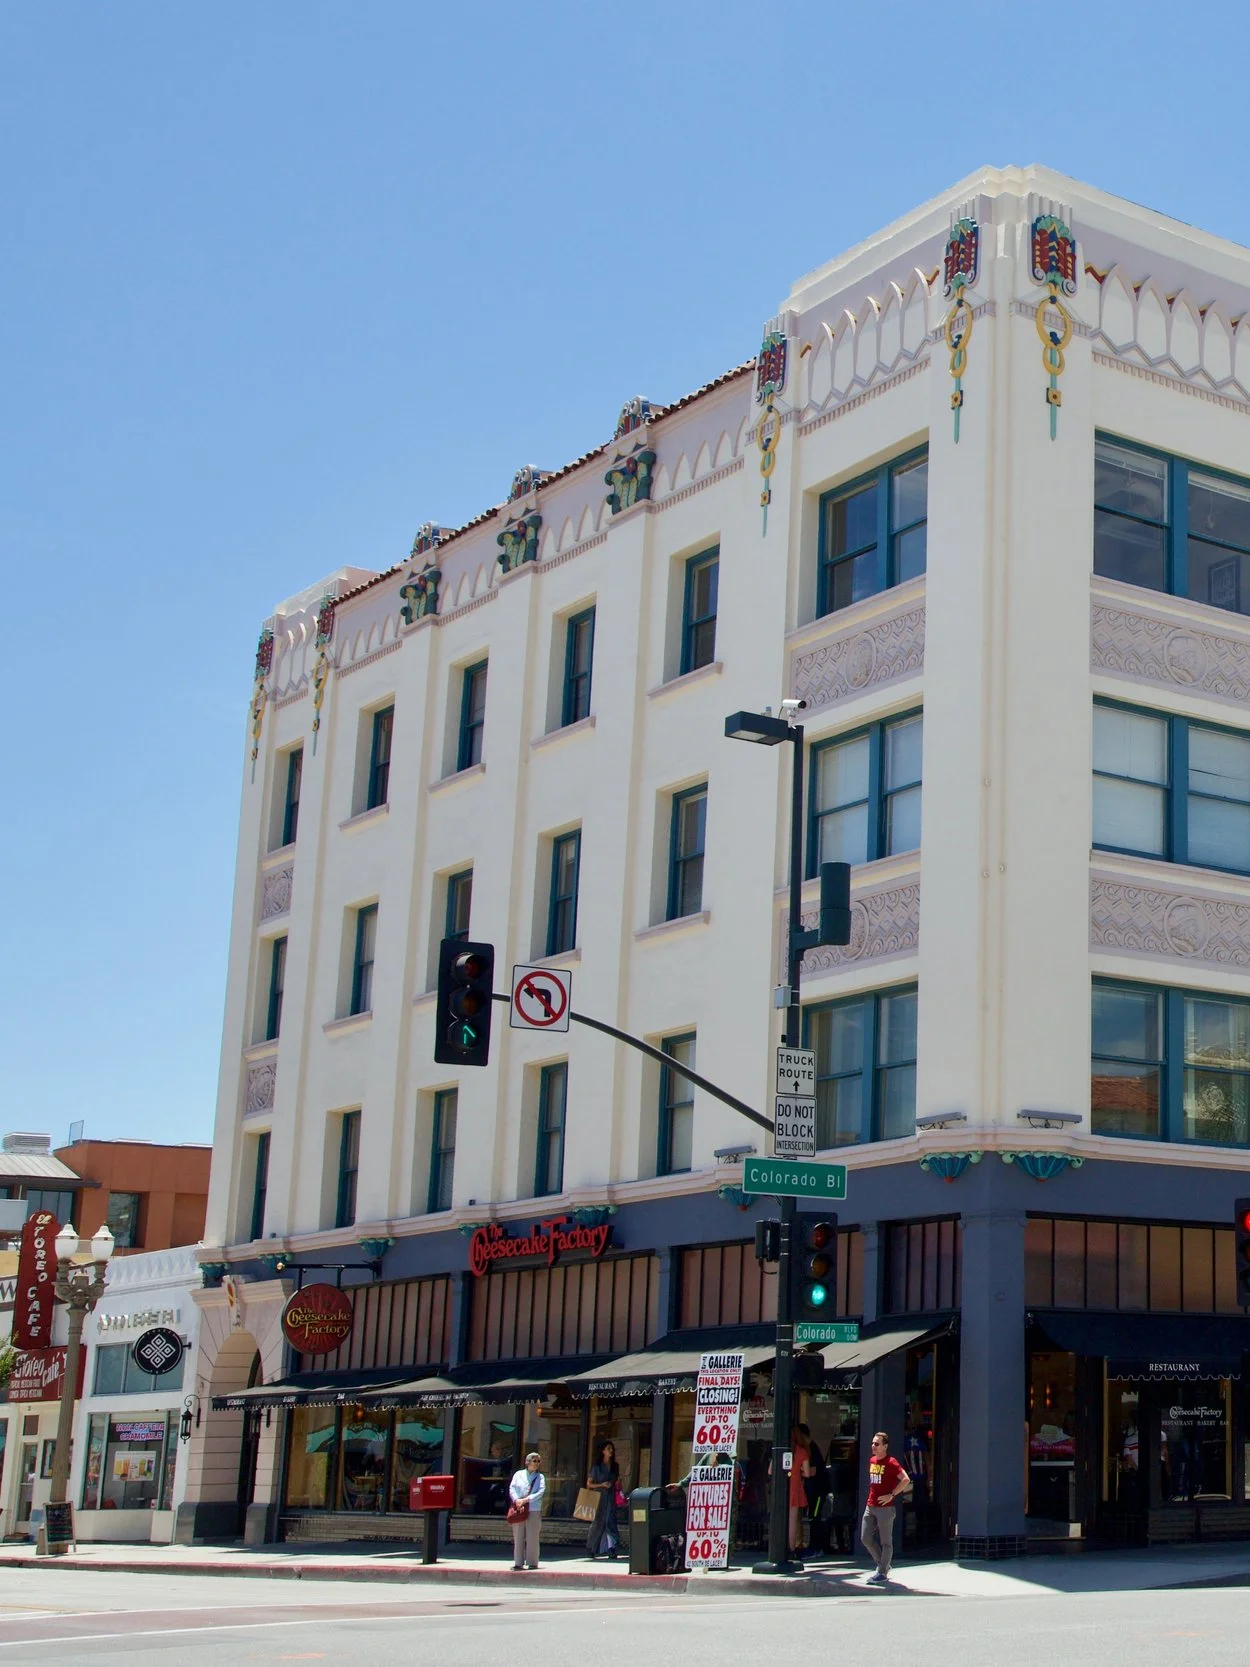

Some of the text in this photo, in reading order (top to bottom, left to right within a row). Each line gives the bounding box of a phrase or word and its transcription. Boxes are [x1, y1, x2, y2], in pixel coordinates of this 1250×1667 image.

[779, 1054, 814, 1066] TRUCK
[779, 1068, 814, 1080] ROUTE
[777, 1104, 814, 1119] DO NOT
[777, 1123, 814, 1138] BLOCK
[776, 1141, 814, 1151] INTERSECTION
[750, 1168, 840, 1188] Colorado Bl
[489, 1223, 502, 1239] The
[469, 1216, 609, 1277] Cheesecake Factory
[34, 1226, 48, 1282] TOREO
[27, 1286, 41, 1337] CAFE
[286, 1307, 351, 1327] Cheesecake
[300, 1320, 349, 1339] Factory
[796, 1325, 836, 1339] Colorado
[708, 1355, 742, 1369] GALLERIE
[1149, 1363, 1200, 1371] RESTAURANT
[588, 1378, 678, 1390] RESTAURANT BAKERY
[698, 1376, 740, 1386] FINAL DAYS!
[699, 1388, 738, 1403] CLOSING!
[698, 1406, 737, 1415] EVERYTHING
[1198, 1406, 1222, 1418] Factory
[721, 1435, 736, 1444] off
[699, 1468, 732, 1481] GALLERIE
[690, 1484, 729, 1506] FIXTURES
[688, 1506, 727, 1529] FOR SALE
[712, 1549, 726, 1559] off
